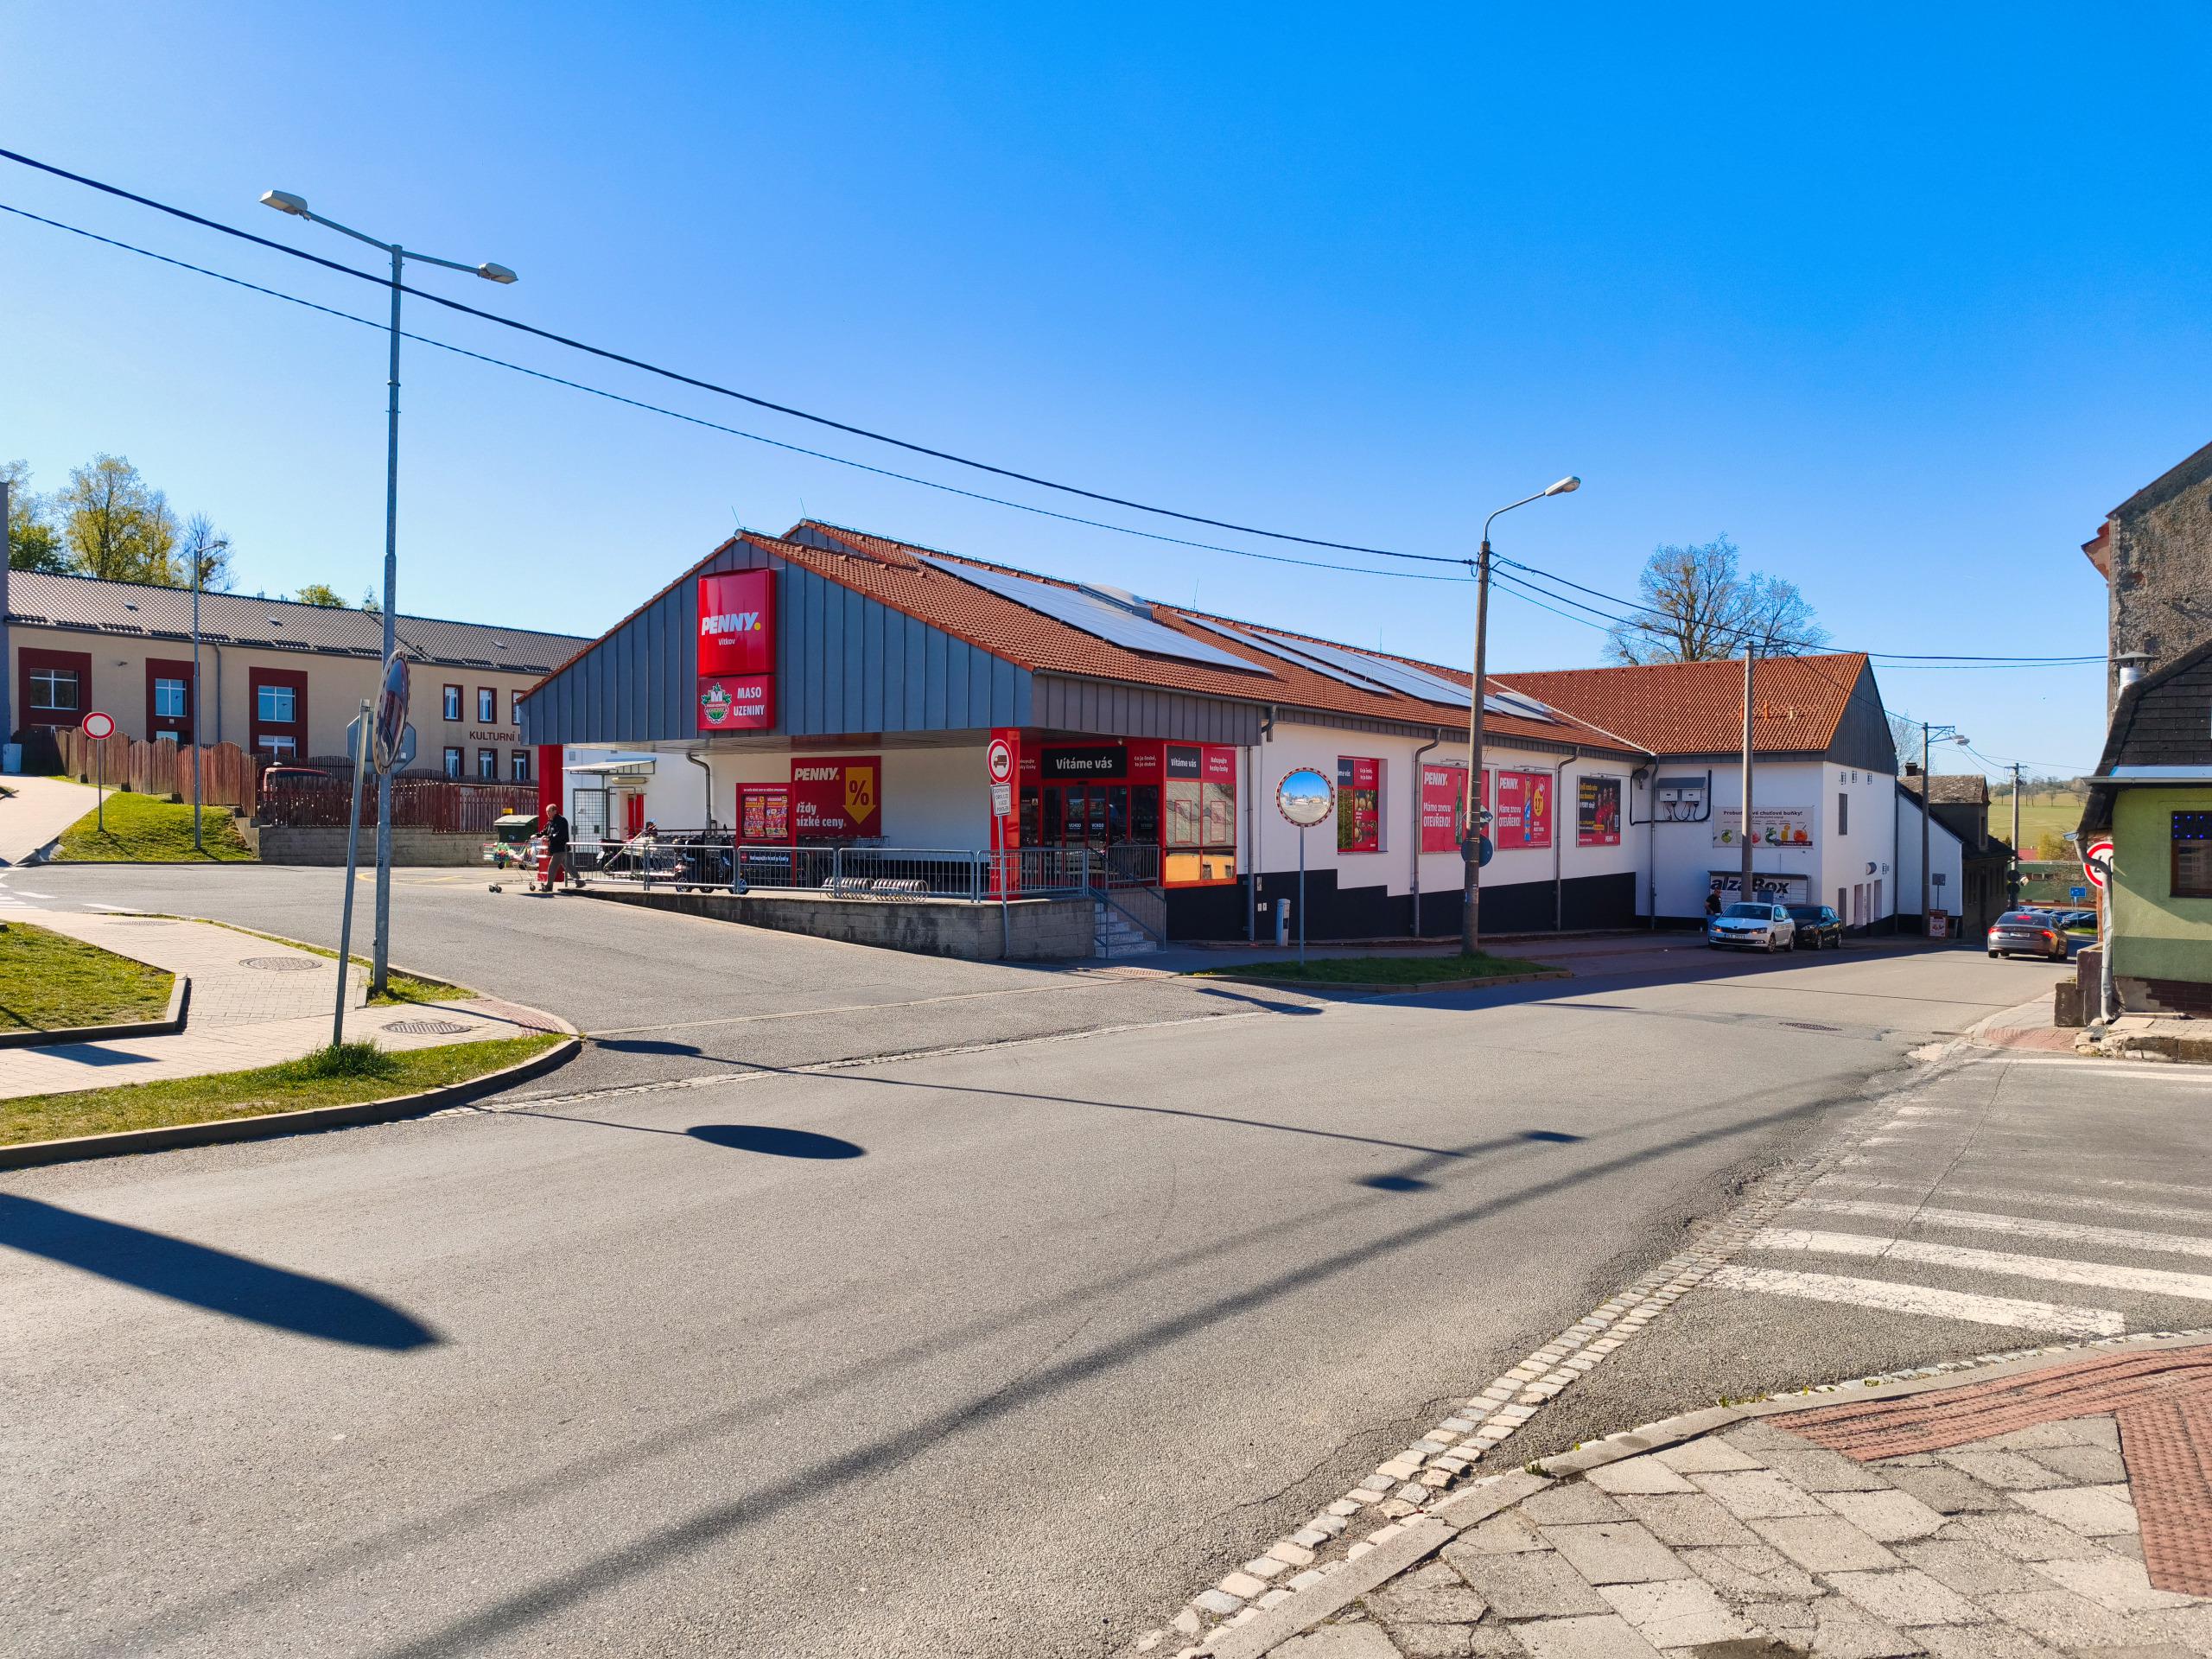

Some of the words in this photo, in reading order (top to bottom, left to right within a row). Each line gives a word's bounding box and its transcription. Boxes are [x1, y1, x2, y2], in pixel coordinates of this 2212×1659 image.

[737, 687, 762, 699] MASO
[734, 705, 765, 716] UZENINY
[469, 731, 515, 742] KULTURNÍ
[1056, 757, 1093, 770] Vítáme
[1095, 756, 1113, 769] vás
[1171, 757, 1188, 767] Vítáme
[1188, 759, 1197, 768] vás
[1423, 801, 1437, 812] Máme
[1423, 813, 1451, 827] OTEVŘENO!
